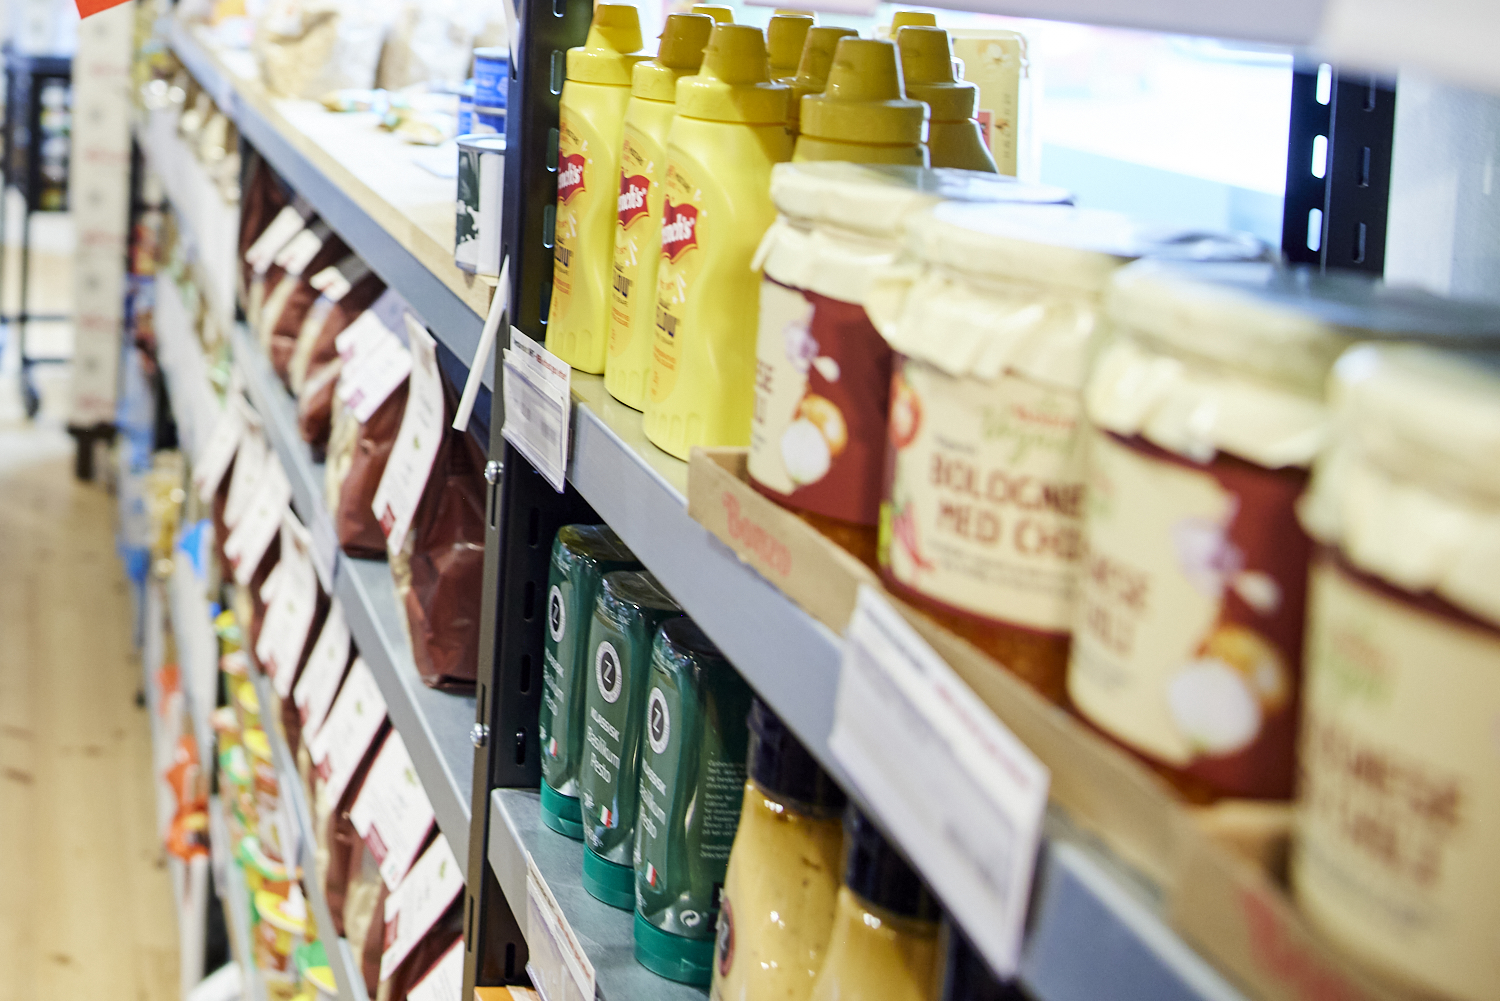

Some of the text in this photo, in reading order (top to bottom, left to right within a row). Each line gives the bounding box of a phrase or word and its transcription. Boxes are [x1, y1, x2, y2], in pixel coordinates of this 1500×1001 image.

[930, 452, 1085, 518] BOLOGNE
[590, 705, 621, 743] KLASSISK
[586, 725, 621, 770] Basilikum
[590, 751, 612, 784] Pesto
